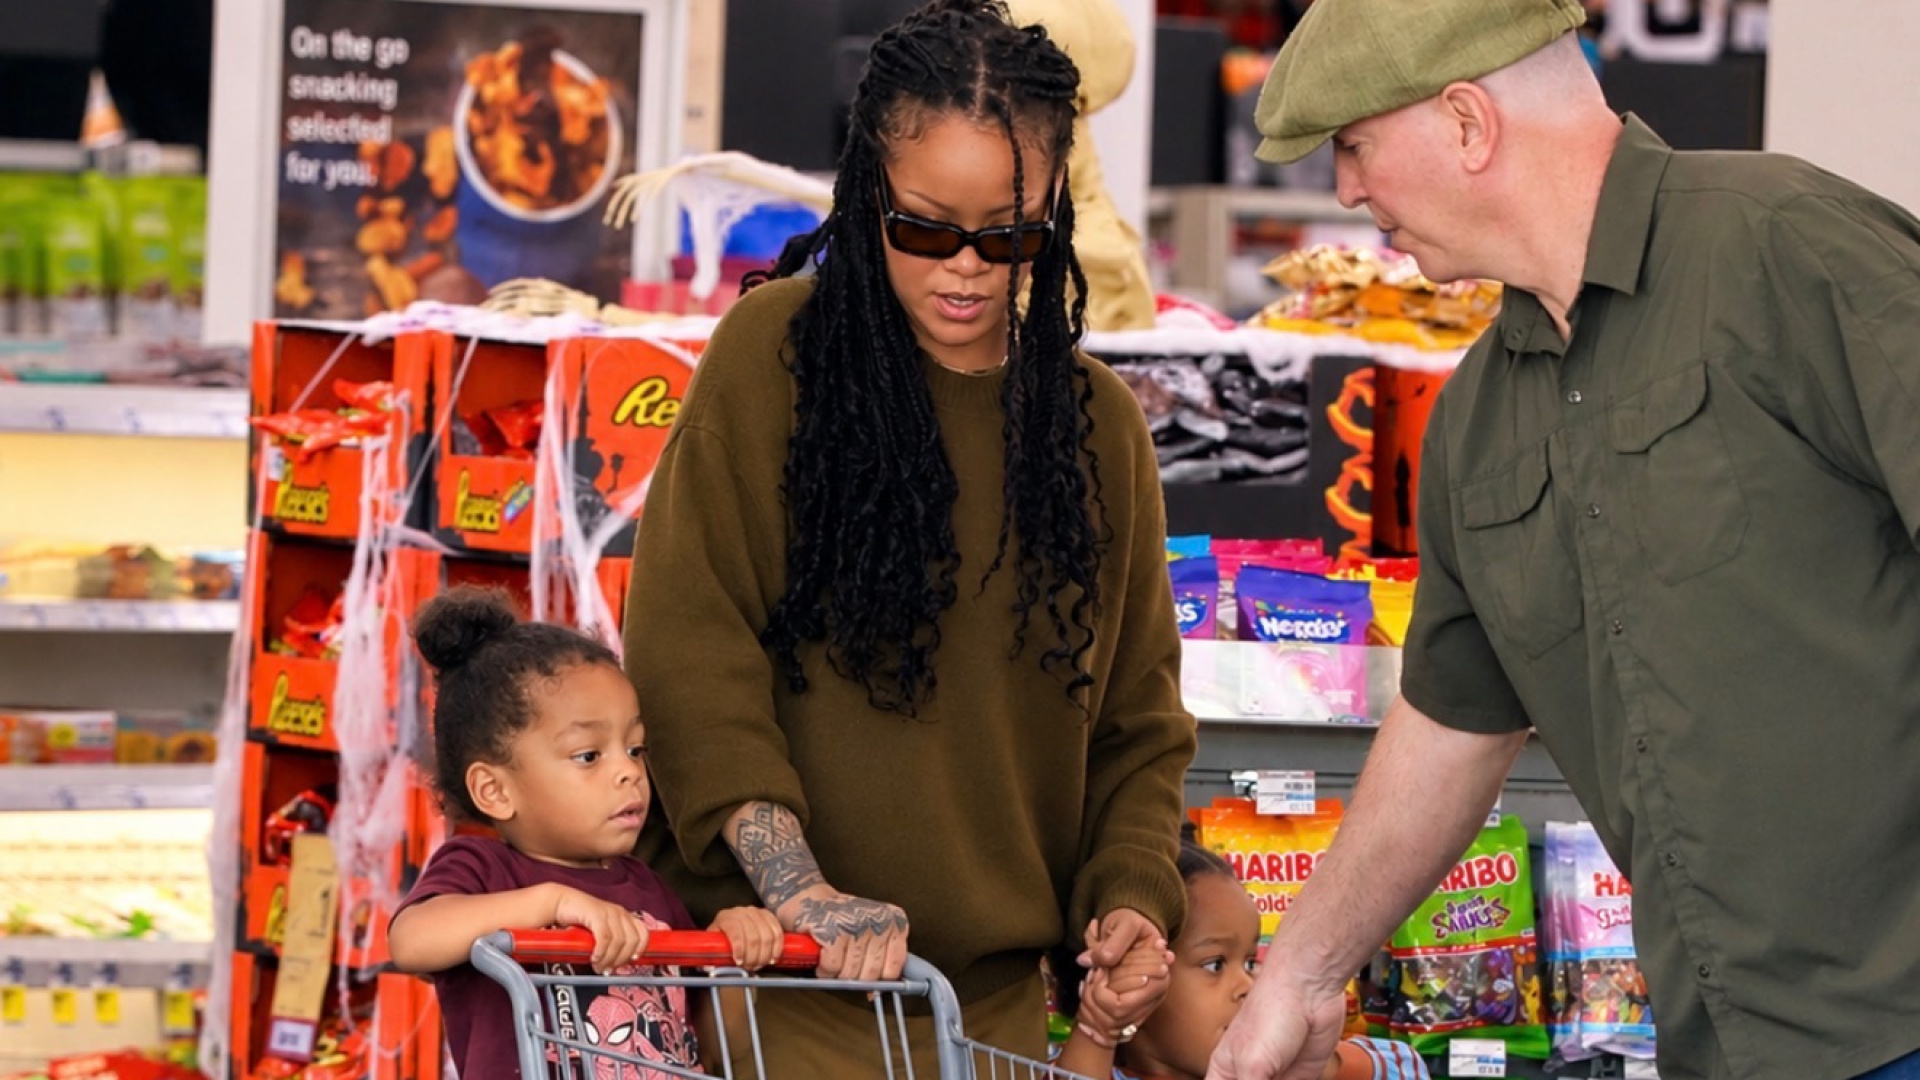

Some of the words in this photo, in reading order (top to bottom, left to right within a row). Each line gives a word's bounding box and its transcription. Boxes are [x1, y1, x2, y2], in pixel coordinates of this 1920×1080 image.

[290, 25, 327, 59] On
[332, 28, 372, 61] the
[375, 38, 410, 69] go
[288, 72, 397, 110] snacking
[287, 111, 393, 145] selected
[286, 151, 320, 184] for
[324, 159, 378, 191] you.
[1225, 852, 1326, 882] HARIB
